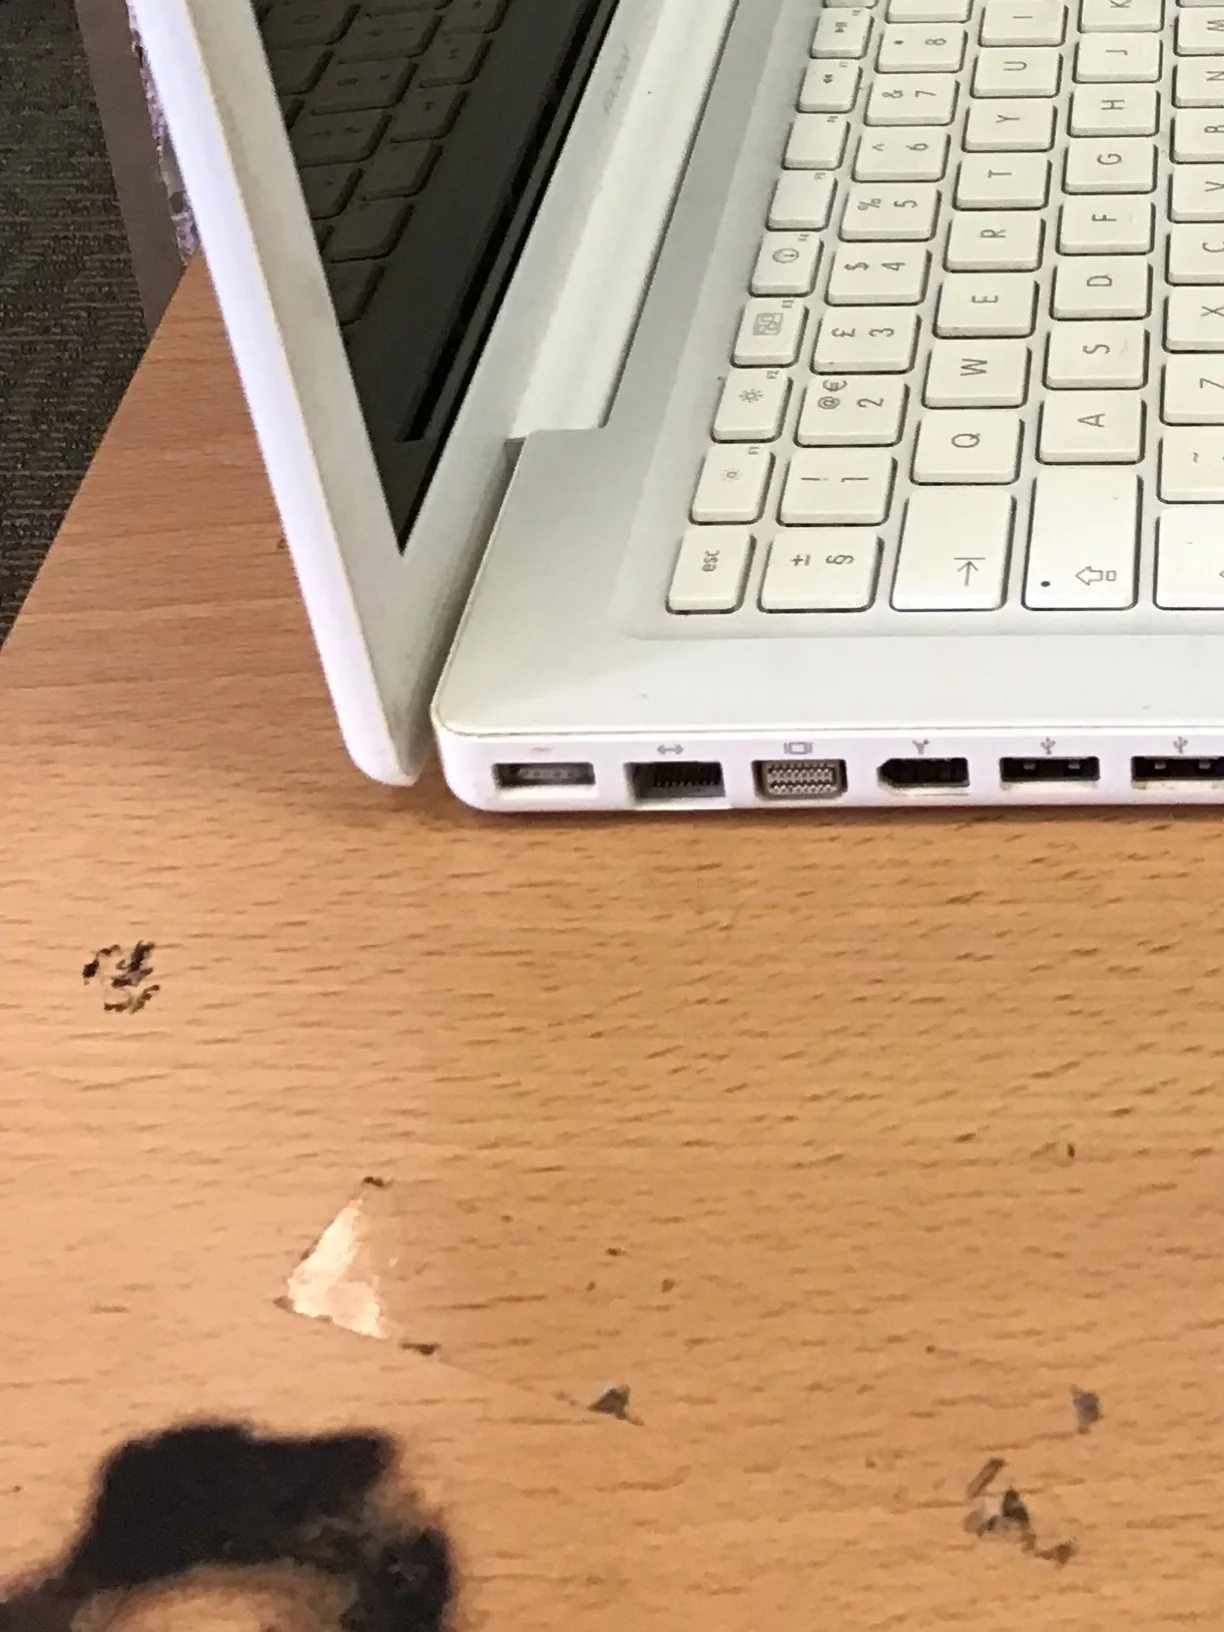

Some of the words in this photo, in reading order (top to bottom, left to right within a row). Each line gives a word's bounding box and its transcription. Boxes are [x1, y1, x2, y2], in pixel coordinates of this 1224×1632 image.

[1110, 0, 1132, 8] K
[925, 38, 947, 46] 8
[1003, 61, 1027, 71] U
[915, 90, 937, 98] 7
[1101, 99, 1125, 110] H
[996, 114, 1020, 123] Y
[906, 143, 929, 151] 6
[1097, 153, 1122, 165] G
[987, 170, 1012, 178] T
[857, 198, 881, 210] %
[894, 199, 917, 208] 5
[980, 230, 1006, 238] R
[881, 261, 906, 271] 4
[1087, 275, 1113, 287] D
[971, 295, 999, 304] E
[832, 328, 856, 337] £
[869, 328, 894, 337] 3
[1082, 344, 1110, 354] S
[960, 358, 988, 375] W
[857, 397, 884, 408] 2
[1077, 413, 1106, 427] A
[951, 433, 981, 448] Q
[702, 550, 720, 572] esc
